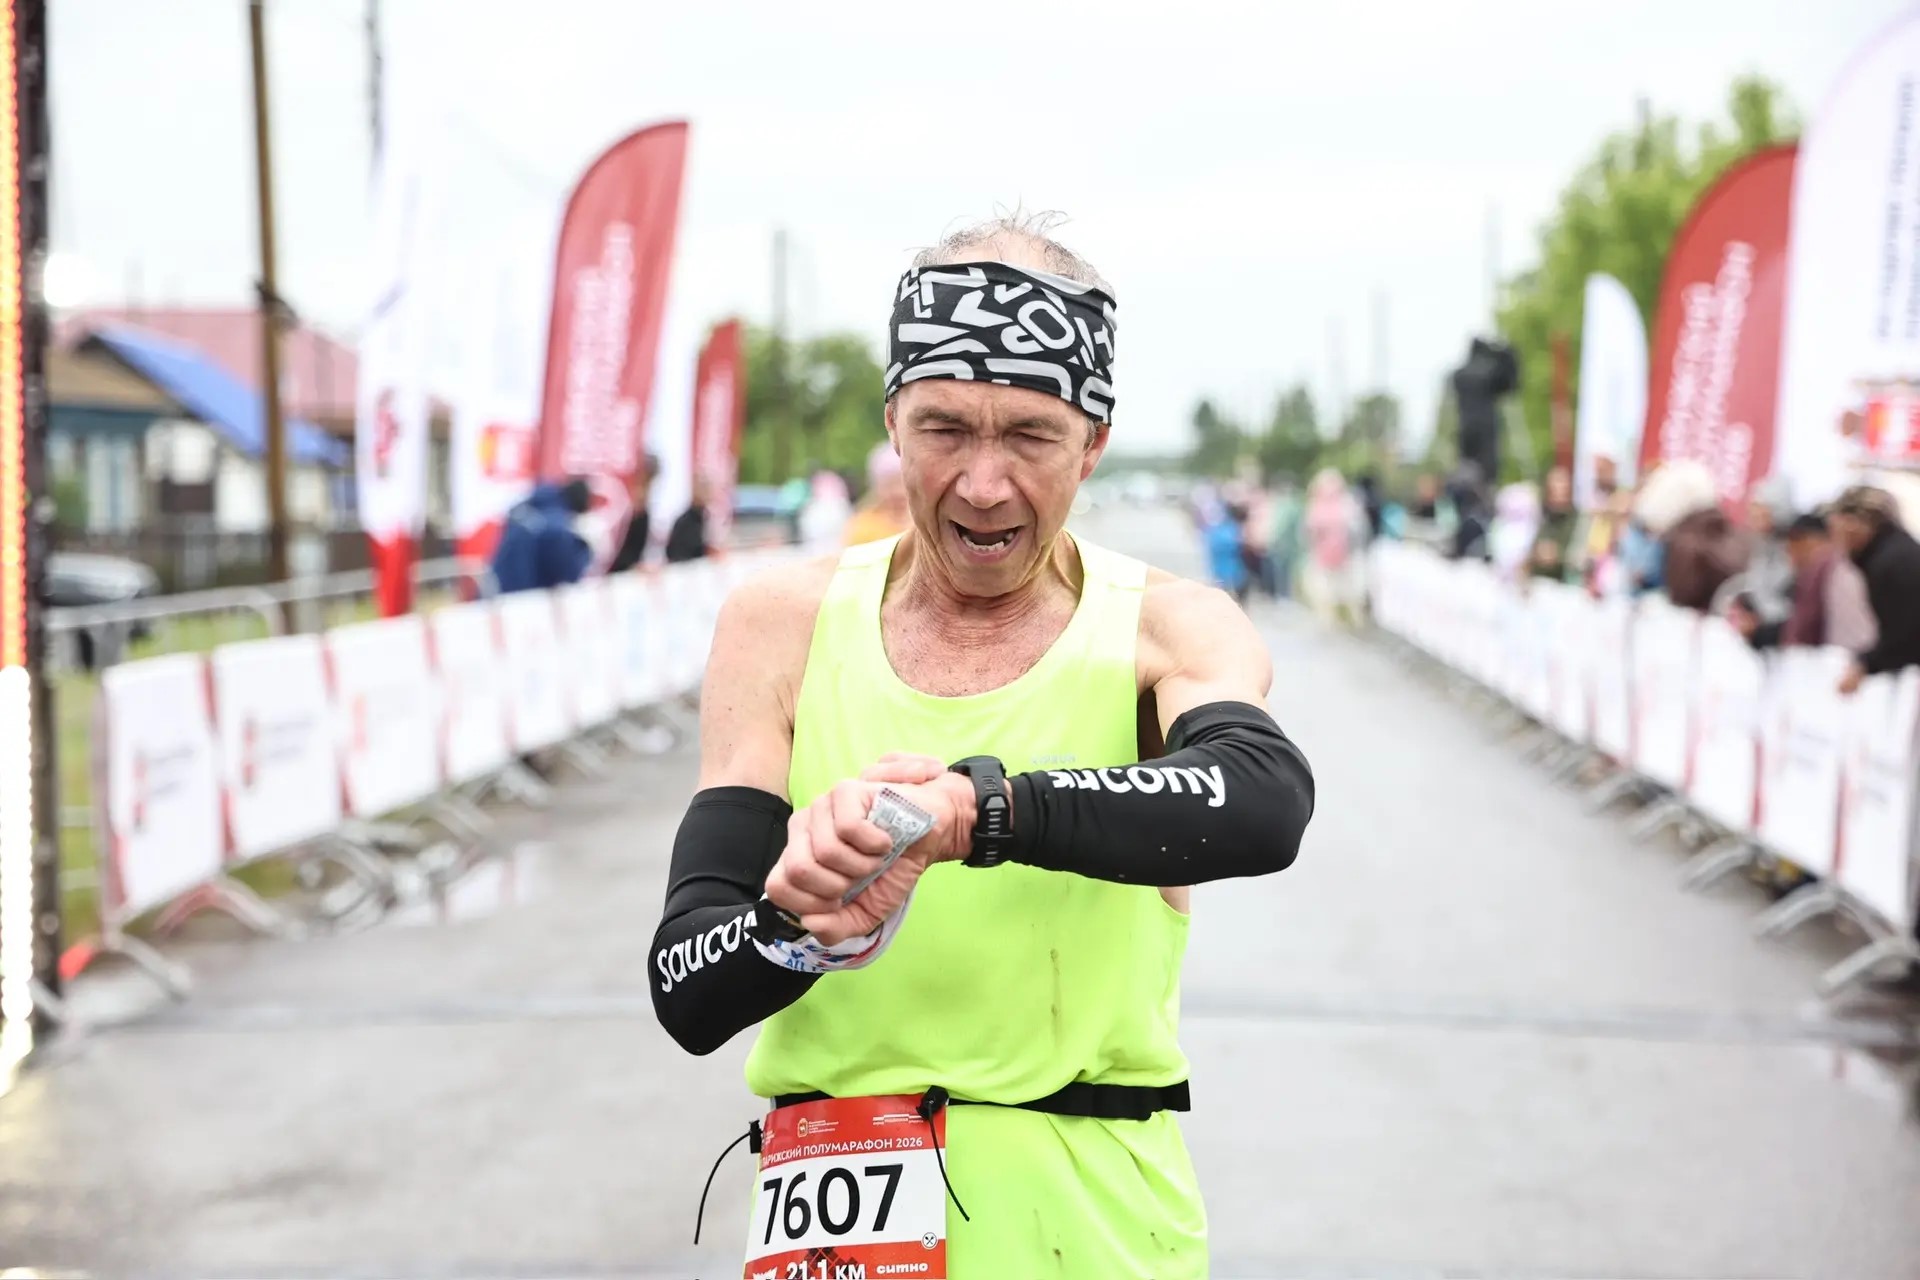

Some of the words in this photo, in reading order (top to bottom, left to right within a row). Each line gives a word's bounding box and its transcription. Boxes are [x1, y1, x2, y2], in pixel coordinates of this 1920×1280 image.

[803, 1138, 893, 1156] ПОЛУМАРАФОН
[895, 1137, 923, 1149] 2026
[763, 1163, 903, 1245] 7607
